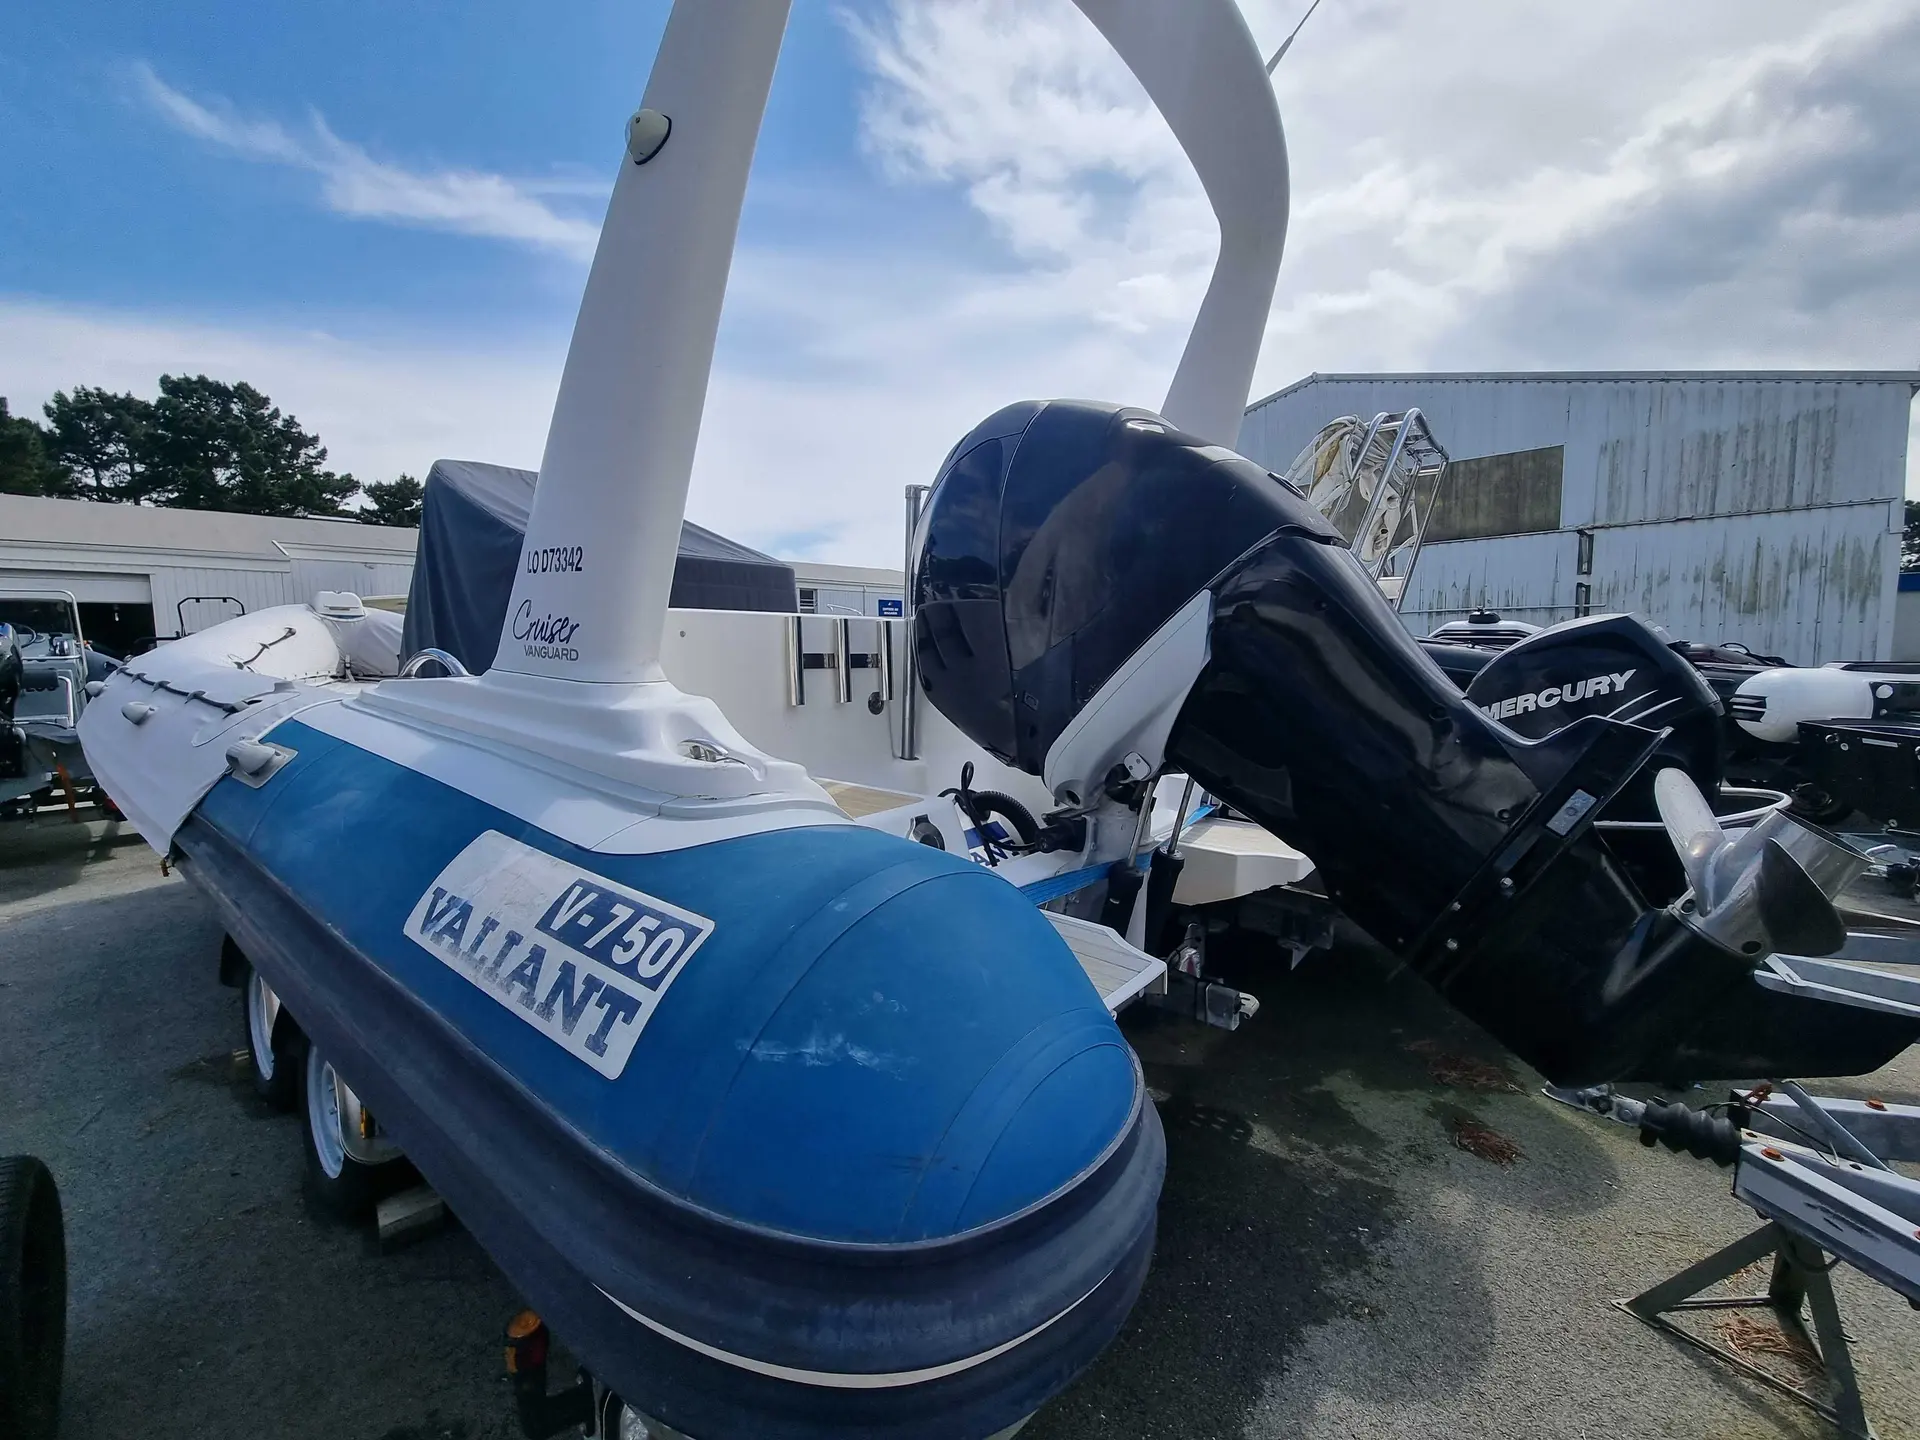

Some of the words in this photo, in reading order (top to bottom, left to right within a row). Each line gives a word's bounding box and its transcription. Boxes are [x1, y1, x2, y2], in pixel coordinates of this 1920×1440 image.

[541, 546, 583, 573] D73342
[513, 599, 580, 644] Cruiser
[524, 645, 579, 661] VANGUARD
[1480, 668, 1636, 721] MERCURY
[549, 885, 686, 979] V-750
[419, 886, 643, 1058] VALIANT
